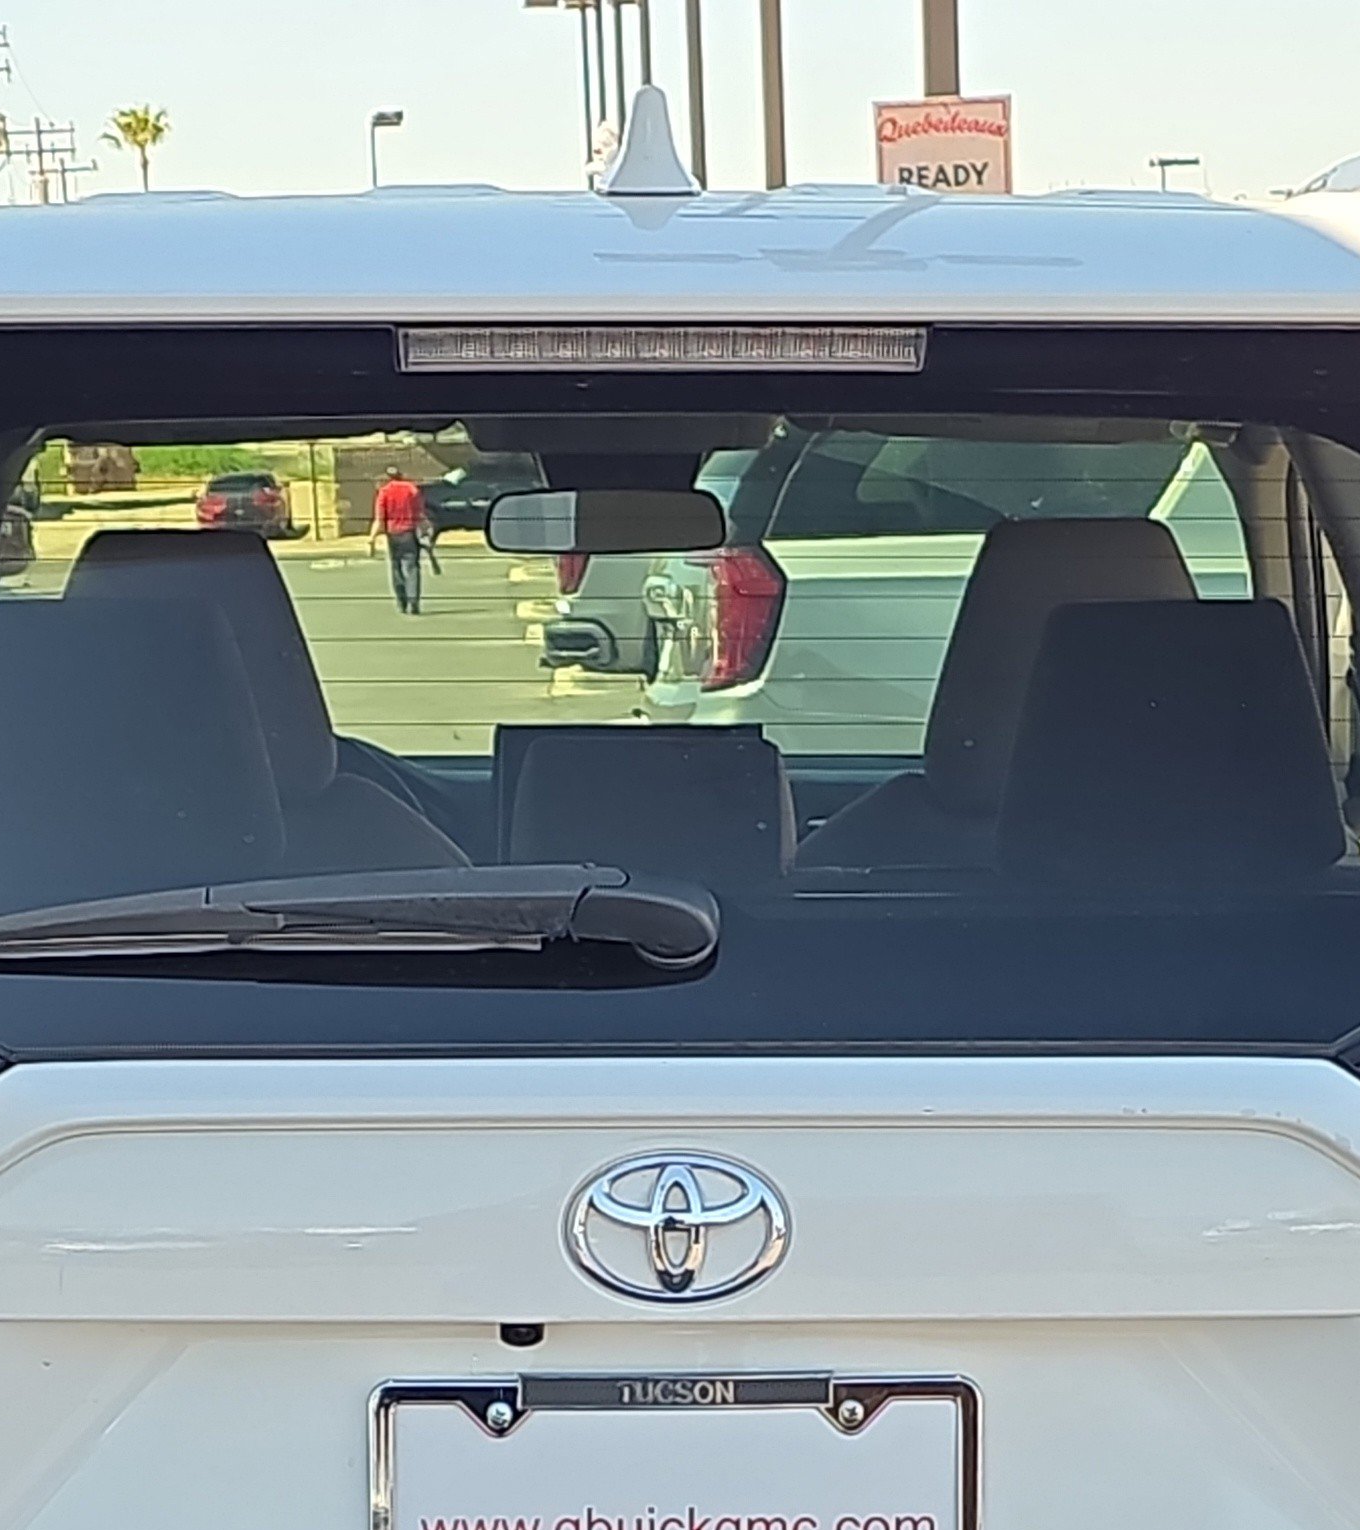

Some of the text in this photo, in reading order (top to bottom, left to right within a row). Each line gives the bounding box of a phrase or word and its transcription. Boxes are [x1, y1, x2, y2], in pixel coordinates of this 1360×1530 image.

[877, 111, 1008, 143] Quebedeaux
[897, 161, 989, 188] READY
[617, 1380, 735, 1404] TUCSON
